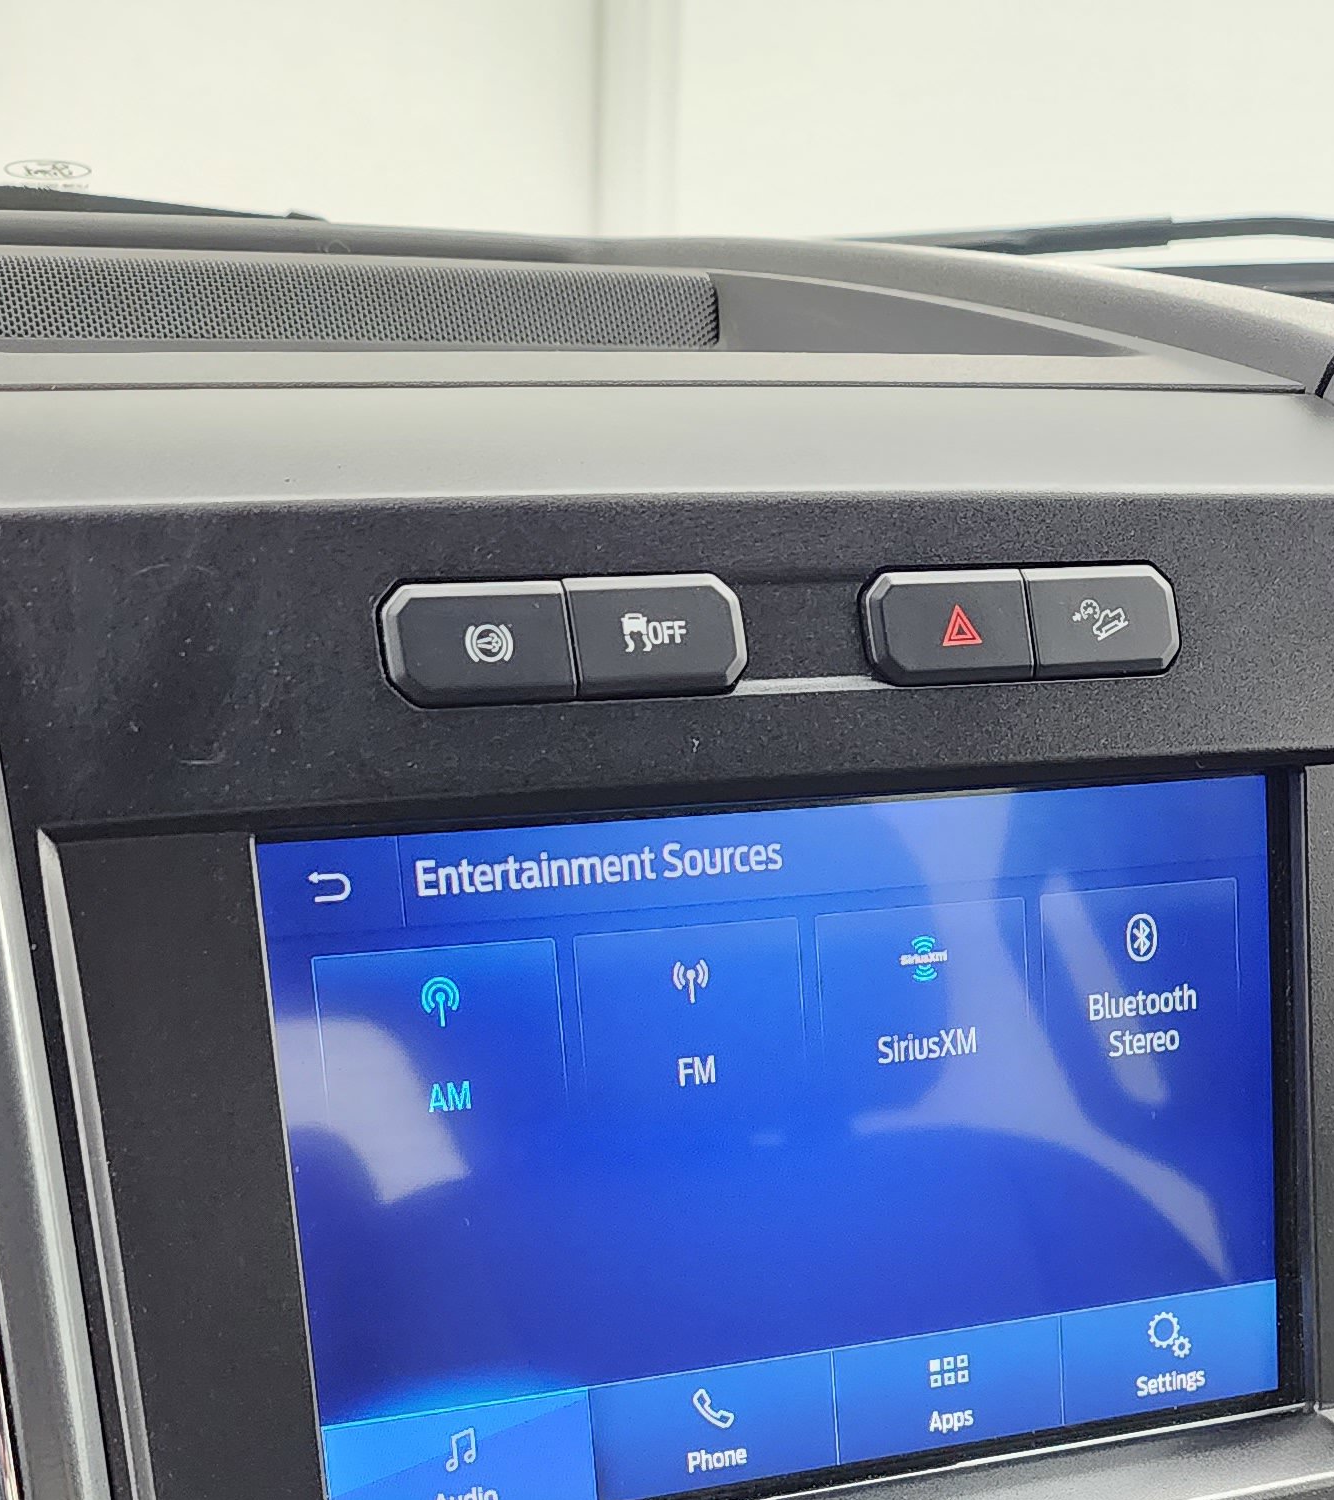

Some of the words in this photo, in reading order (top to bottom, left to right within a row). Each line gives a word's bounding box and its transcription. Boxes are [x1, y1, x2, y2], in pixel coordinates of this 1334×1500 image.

[648, 620, 687, 645] OFF
[415, 845, 656, 898] Entertainment
[663, 840, 784, 879] Sources
[1088, 983, 1197, 1021] Bluetooth
[877, 1027, 978, 1065] SiriusXM
[1108, 1029, 1180, 1058] Stereo
[677, 1055, 717, 1088] FM
[428, 1080, 473, 1113] AM
[1135, 1368, 1207, 1398] Settings
[929, 1406, 975, 1433] Apps
[686, 1444, 748, 1473] Phone
